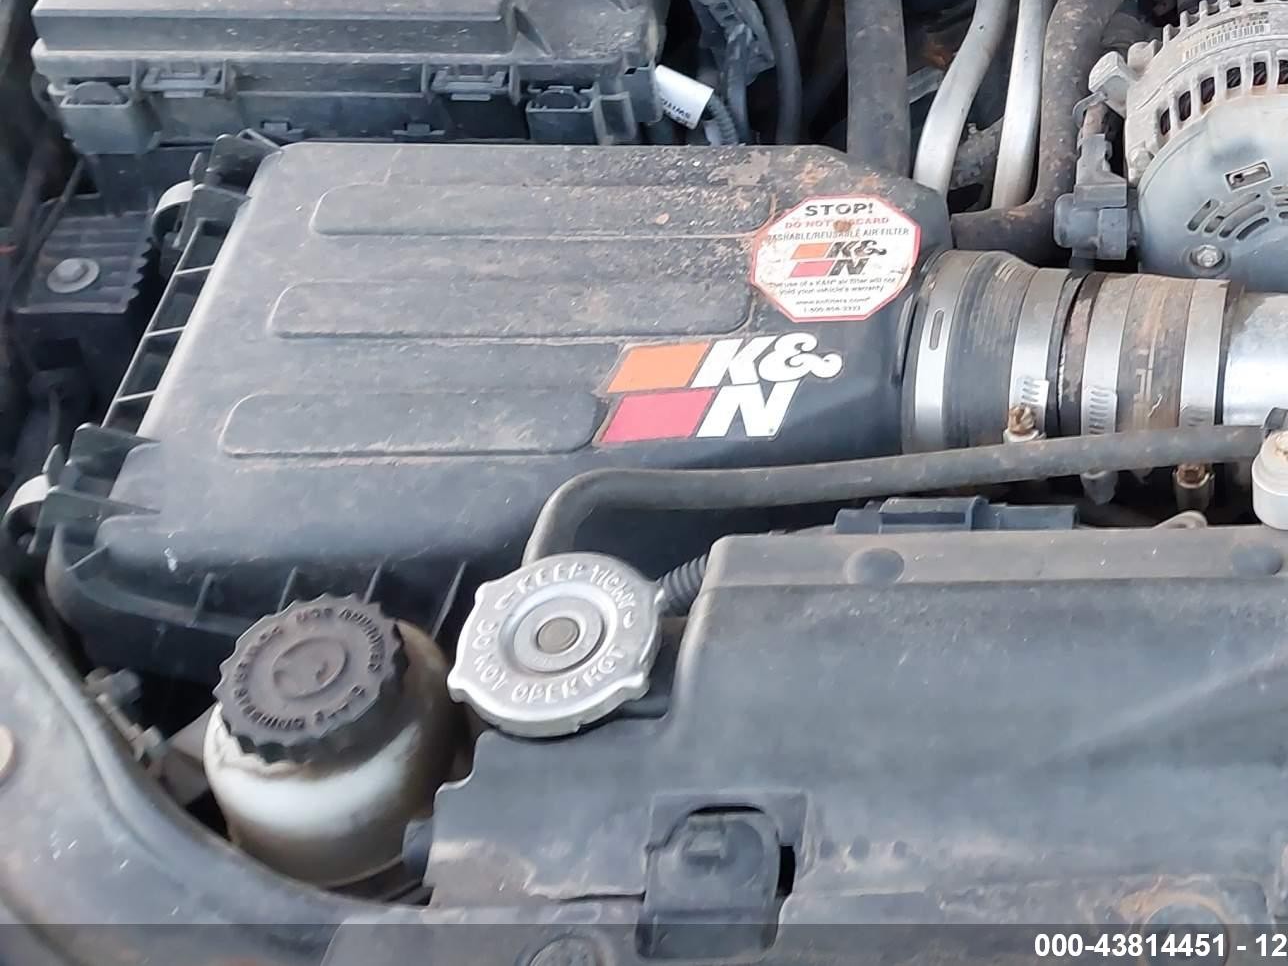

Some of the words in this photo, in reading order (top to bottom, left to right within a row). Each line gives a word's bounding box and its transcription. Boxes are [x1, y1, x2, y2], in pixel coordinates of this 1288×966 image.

[805, 203, 874, 217] STOP!
[785, 220, 802, 229] DO
[805, 218, 832, 228] NOT
[517, 561, 587, 594] KEEP
[472, 653, 508, 691] NOT
[511, 680, 580, 704] OPEN
[582, 643, 626, 687] HOT
